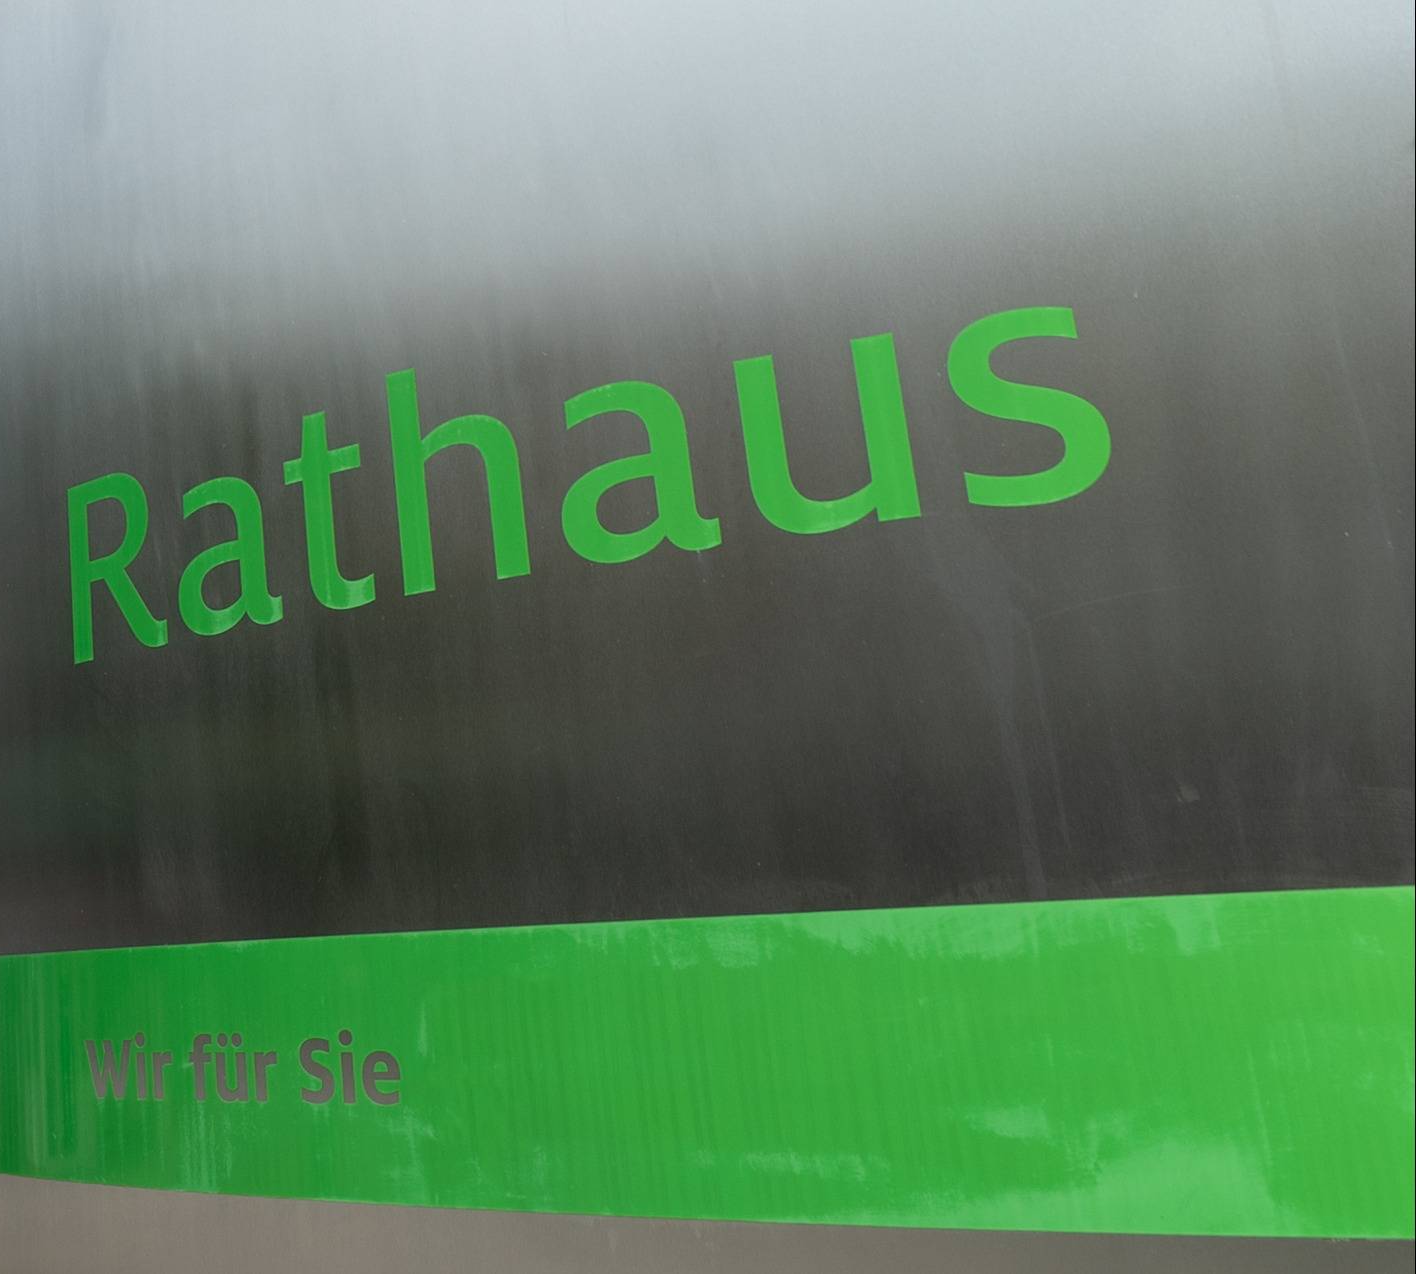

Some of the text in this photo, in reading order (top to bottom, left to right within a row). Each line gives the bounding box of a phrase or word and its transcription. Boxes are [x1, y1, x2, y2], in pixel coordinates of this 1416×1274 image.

[67, 307, 1111, 665] Rathaus
[85, 1030, 401, 1105] Wir für Sie
